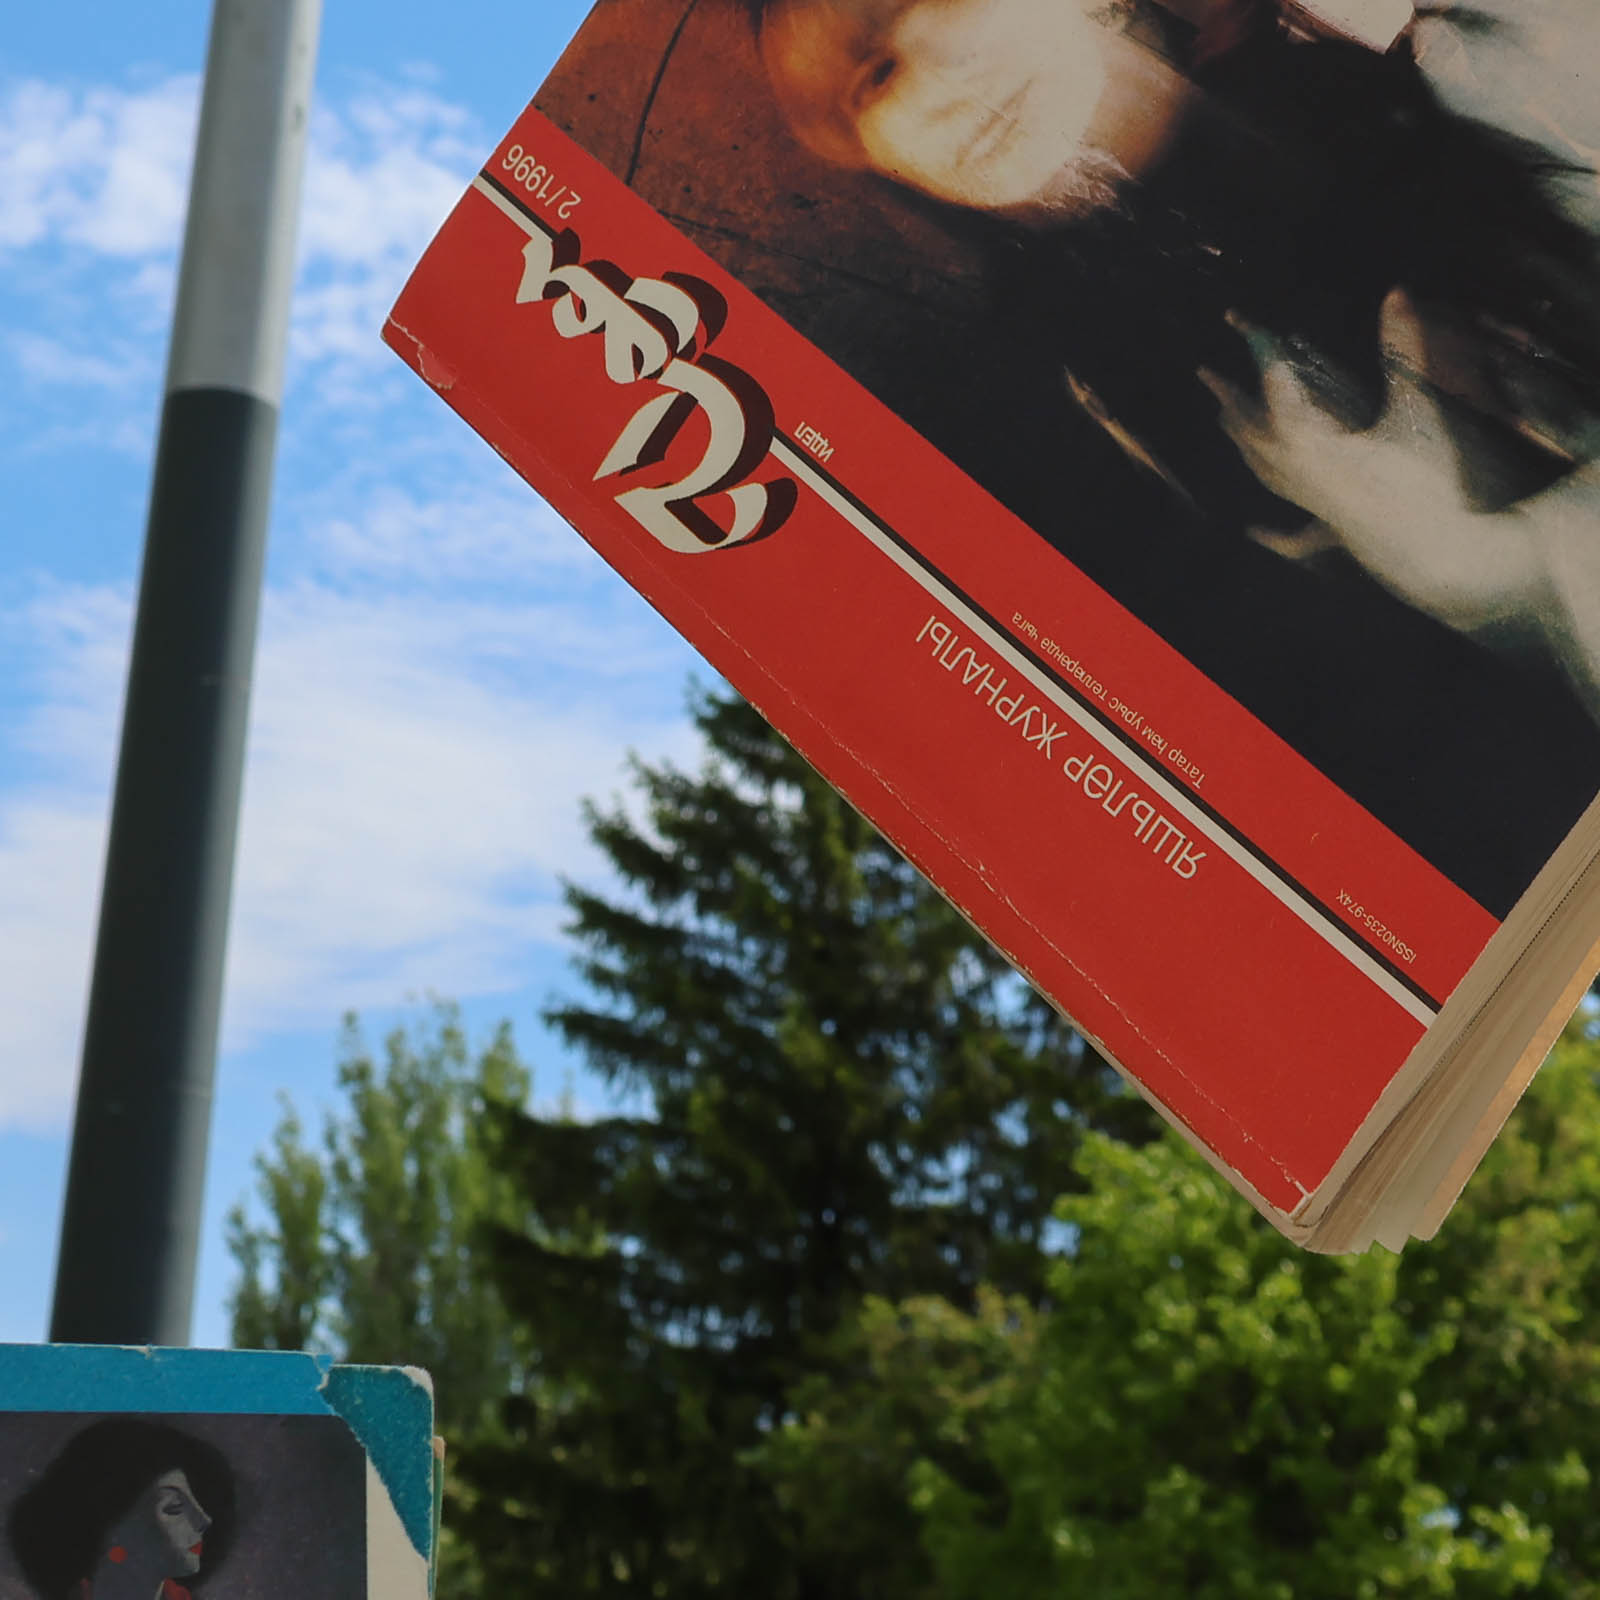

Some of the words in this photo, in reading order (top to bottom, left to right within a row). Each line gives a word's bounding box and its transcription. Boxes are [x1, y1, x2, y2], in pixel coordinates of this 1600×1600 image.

[501, 142, 582, 220] 2/1996
[794, 420, 835, 463] ИДЕЛ
[1012, 611, 1039, 641] чыга
[915, 614, 1068, 760] ЖУРНАЛЫ
[1108, 696, 1145, 730] урыс
[1141, 724, 1169, 755] һәм
[1168, 748, 1206, 789] Татар
[1063, 753, 1208, 881] ЯШЬЛӘР
